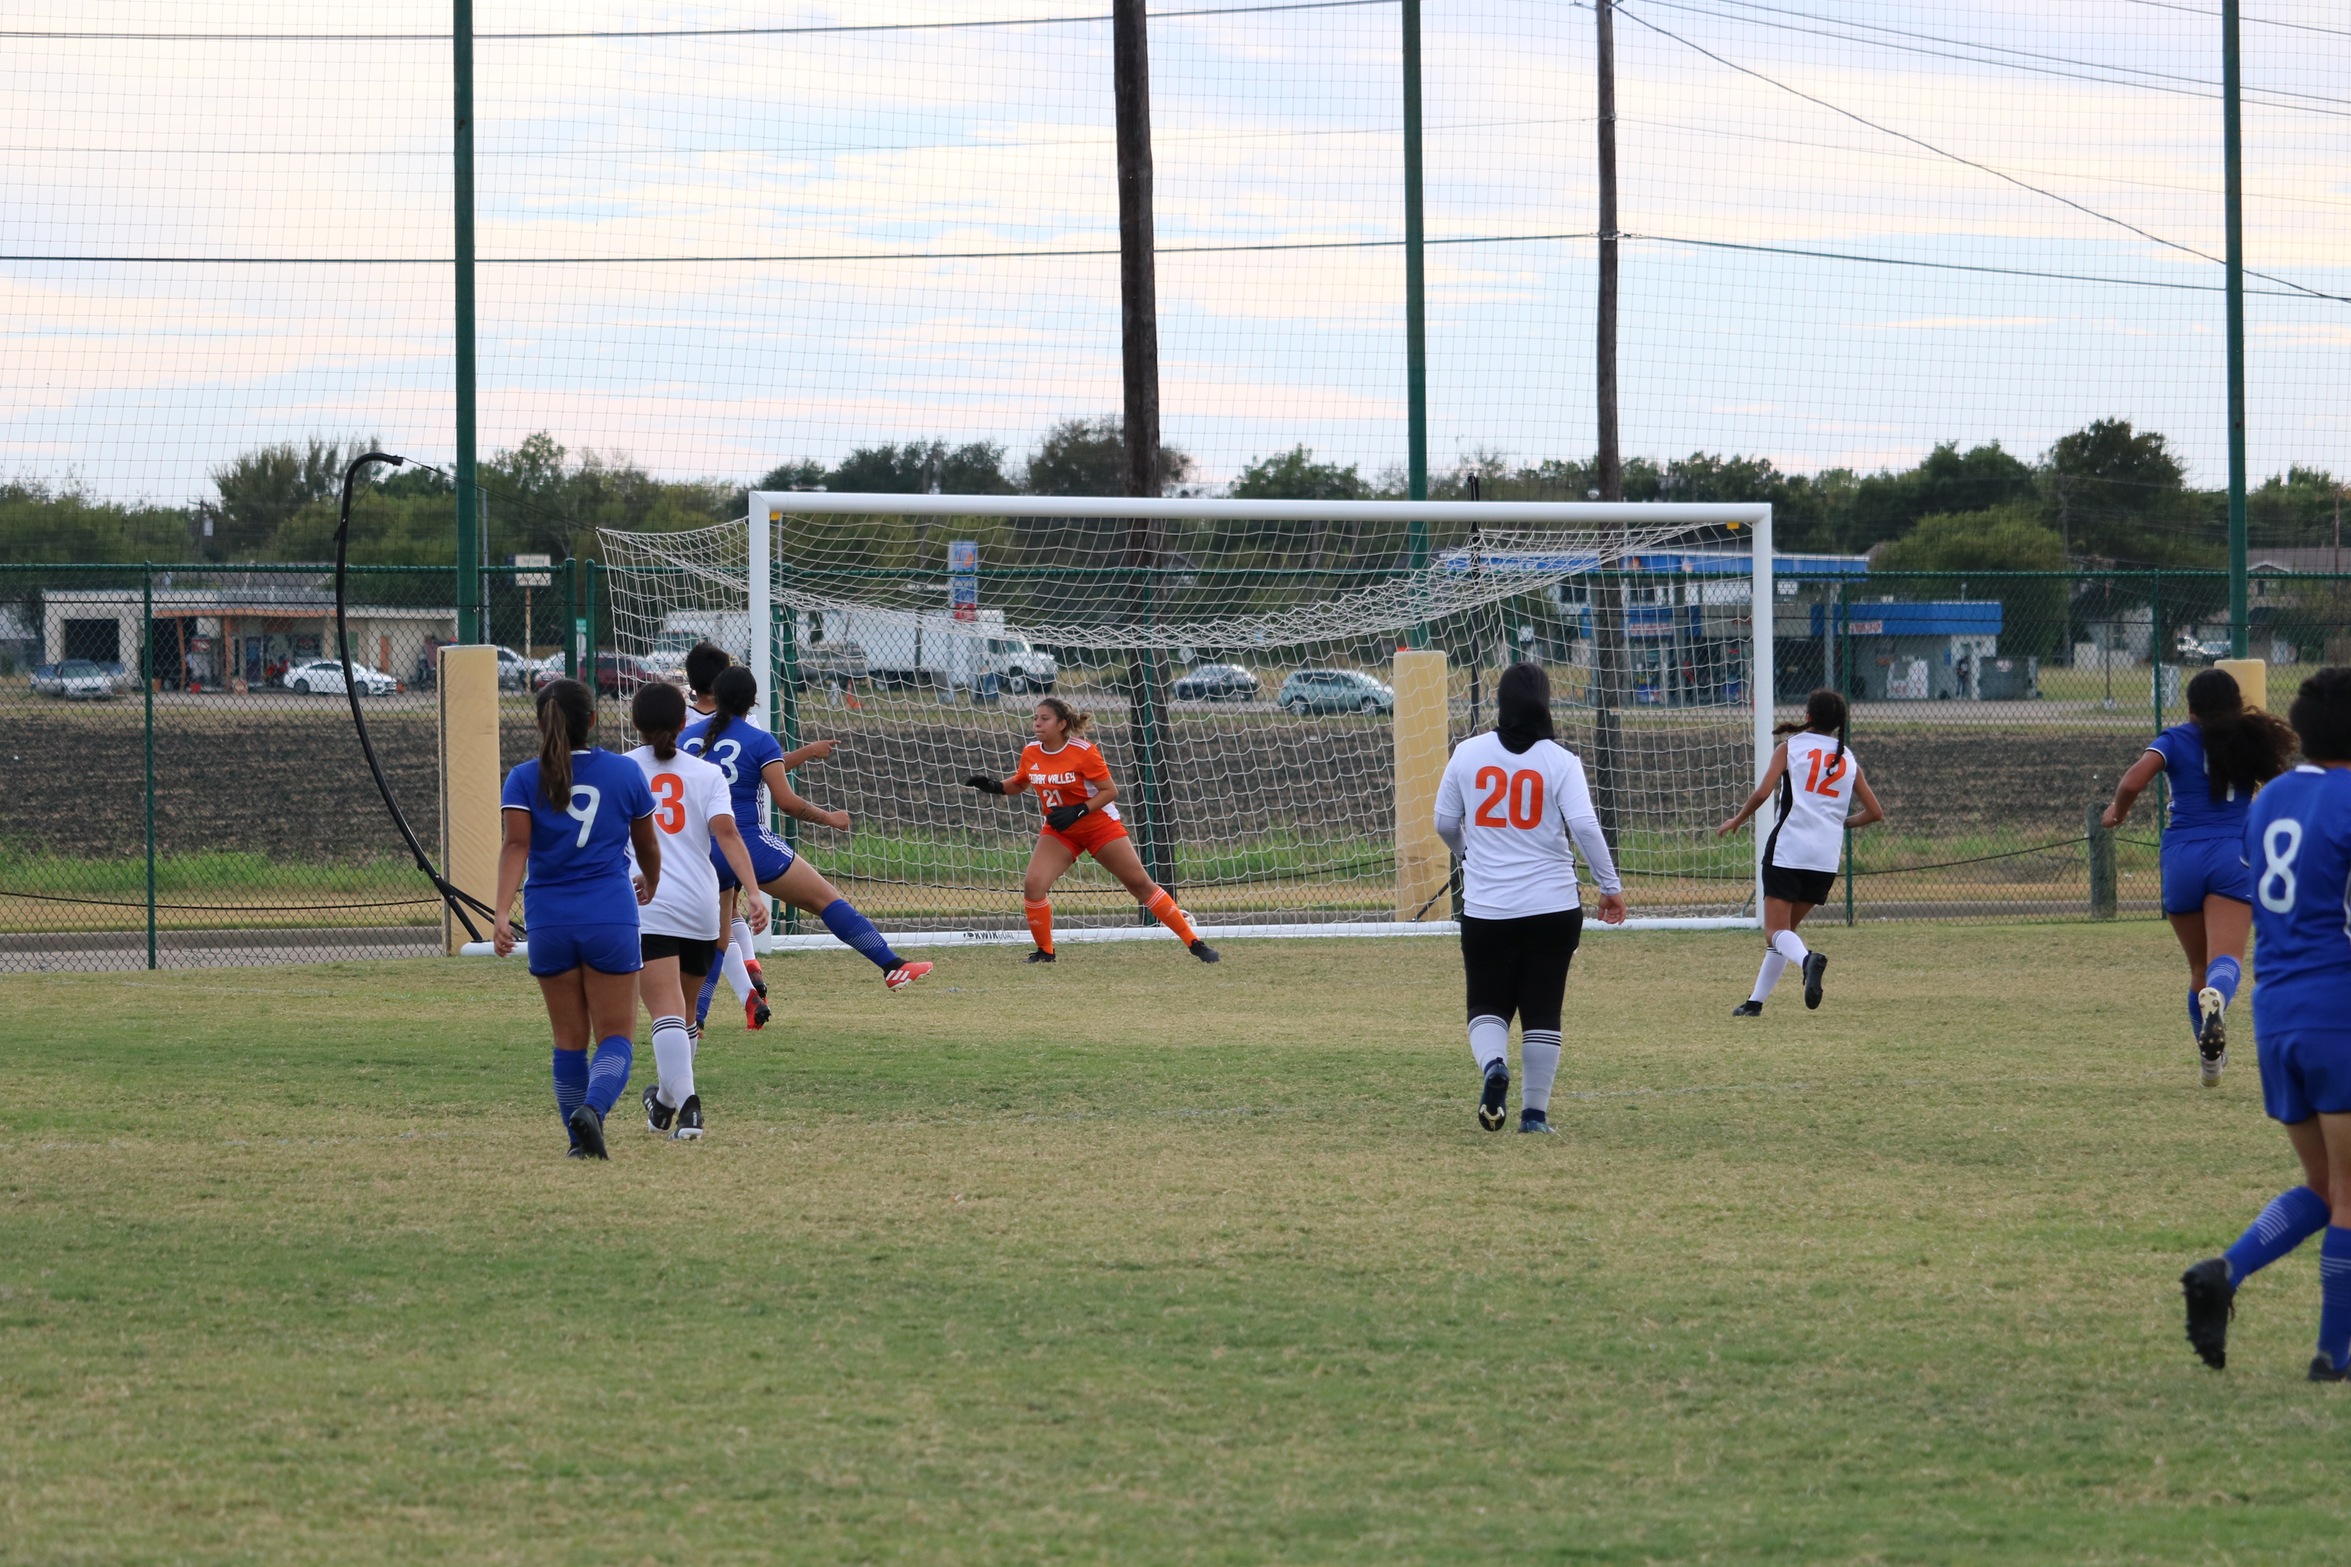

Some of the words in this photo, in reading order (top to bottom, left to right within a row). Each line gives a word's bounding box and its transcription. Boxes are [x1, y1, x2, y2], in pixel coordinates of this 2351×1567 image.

[650, 773, 686, 834] 3
[1042, 789, 1063, 807] 21
[1048, 771, 1076, 784] VALLEY
[1475, 766, 1544, 830] 20
[1805, 749, 1847, 798] 12
[566, 784, 601, 848] 9
[2258, 818, 2302, 913] 8
